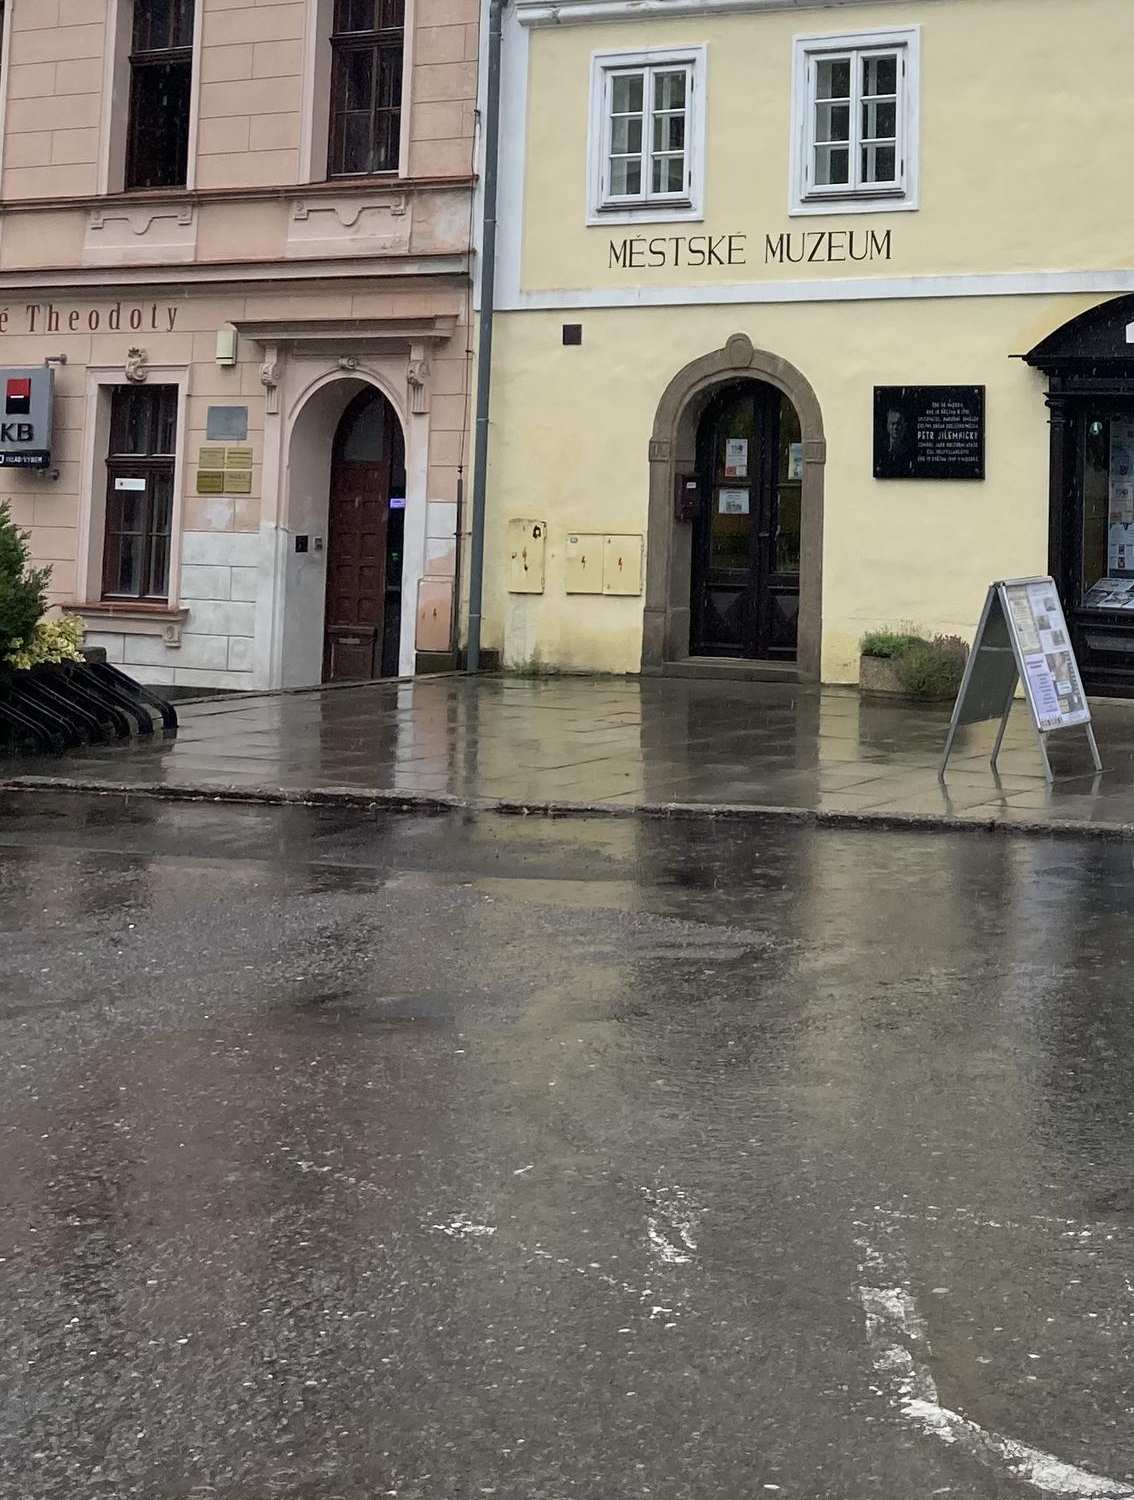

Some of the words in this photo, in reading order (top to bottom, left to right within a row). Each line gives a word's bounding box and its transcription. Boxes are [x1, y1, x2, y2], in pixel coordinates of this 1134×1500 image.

[608, 231, 747, 268] MĚSTSKÉ
[764, 229, 892, 264] MUZEUM
[26, 302, 178, 332] Theodoty
[0, 423, 34, 442] KB
